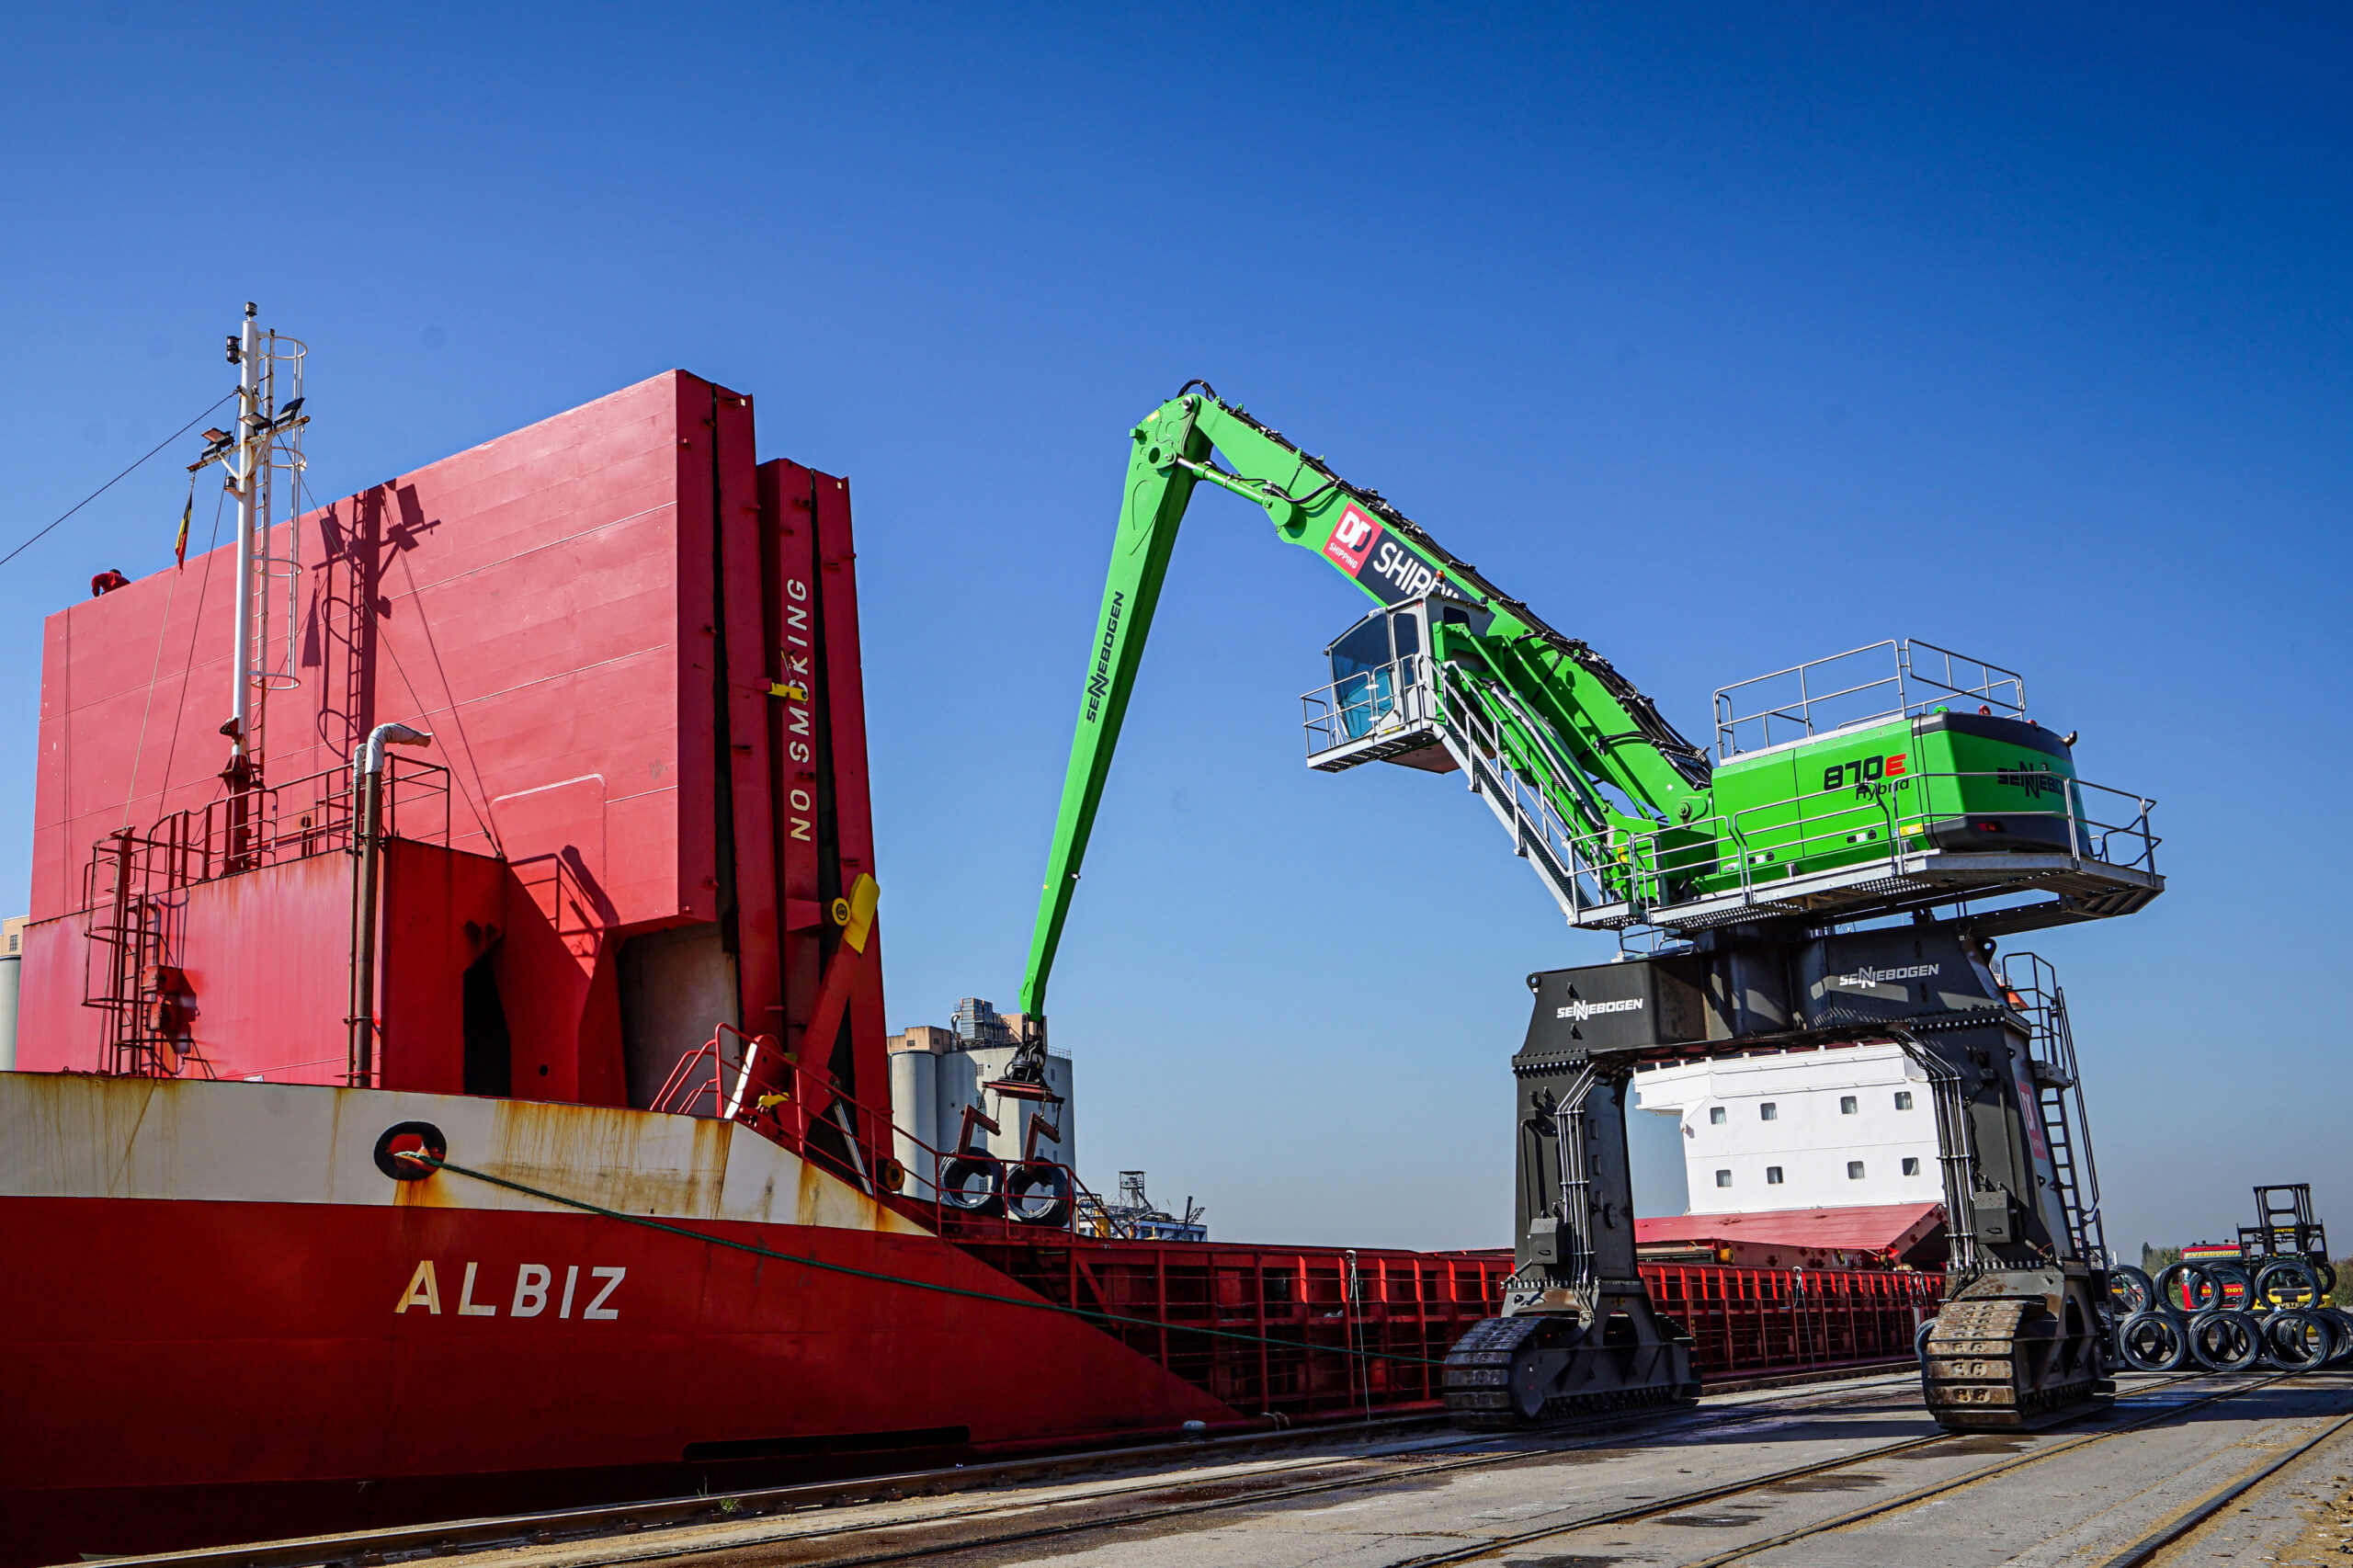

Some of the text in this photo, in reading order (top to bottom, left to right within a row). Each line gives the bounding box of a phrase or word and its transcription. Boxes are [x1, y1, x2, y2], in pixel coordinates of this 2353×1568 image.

[1328, 542, 1358, 569] SHIPPING
[1086, 590, 1125, 723] SENNEBOGEN
[1824, 752, 1907, 791] 870E
[790, 789, 811, 842] NO
[1838, 962, 1939, 989] SENNEBOGEN
[1556, 998, 1643, 1021] SENNEBOGEN
[393, 1259, 627, 1320] ALBIZ
